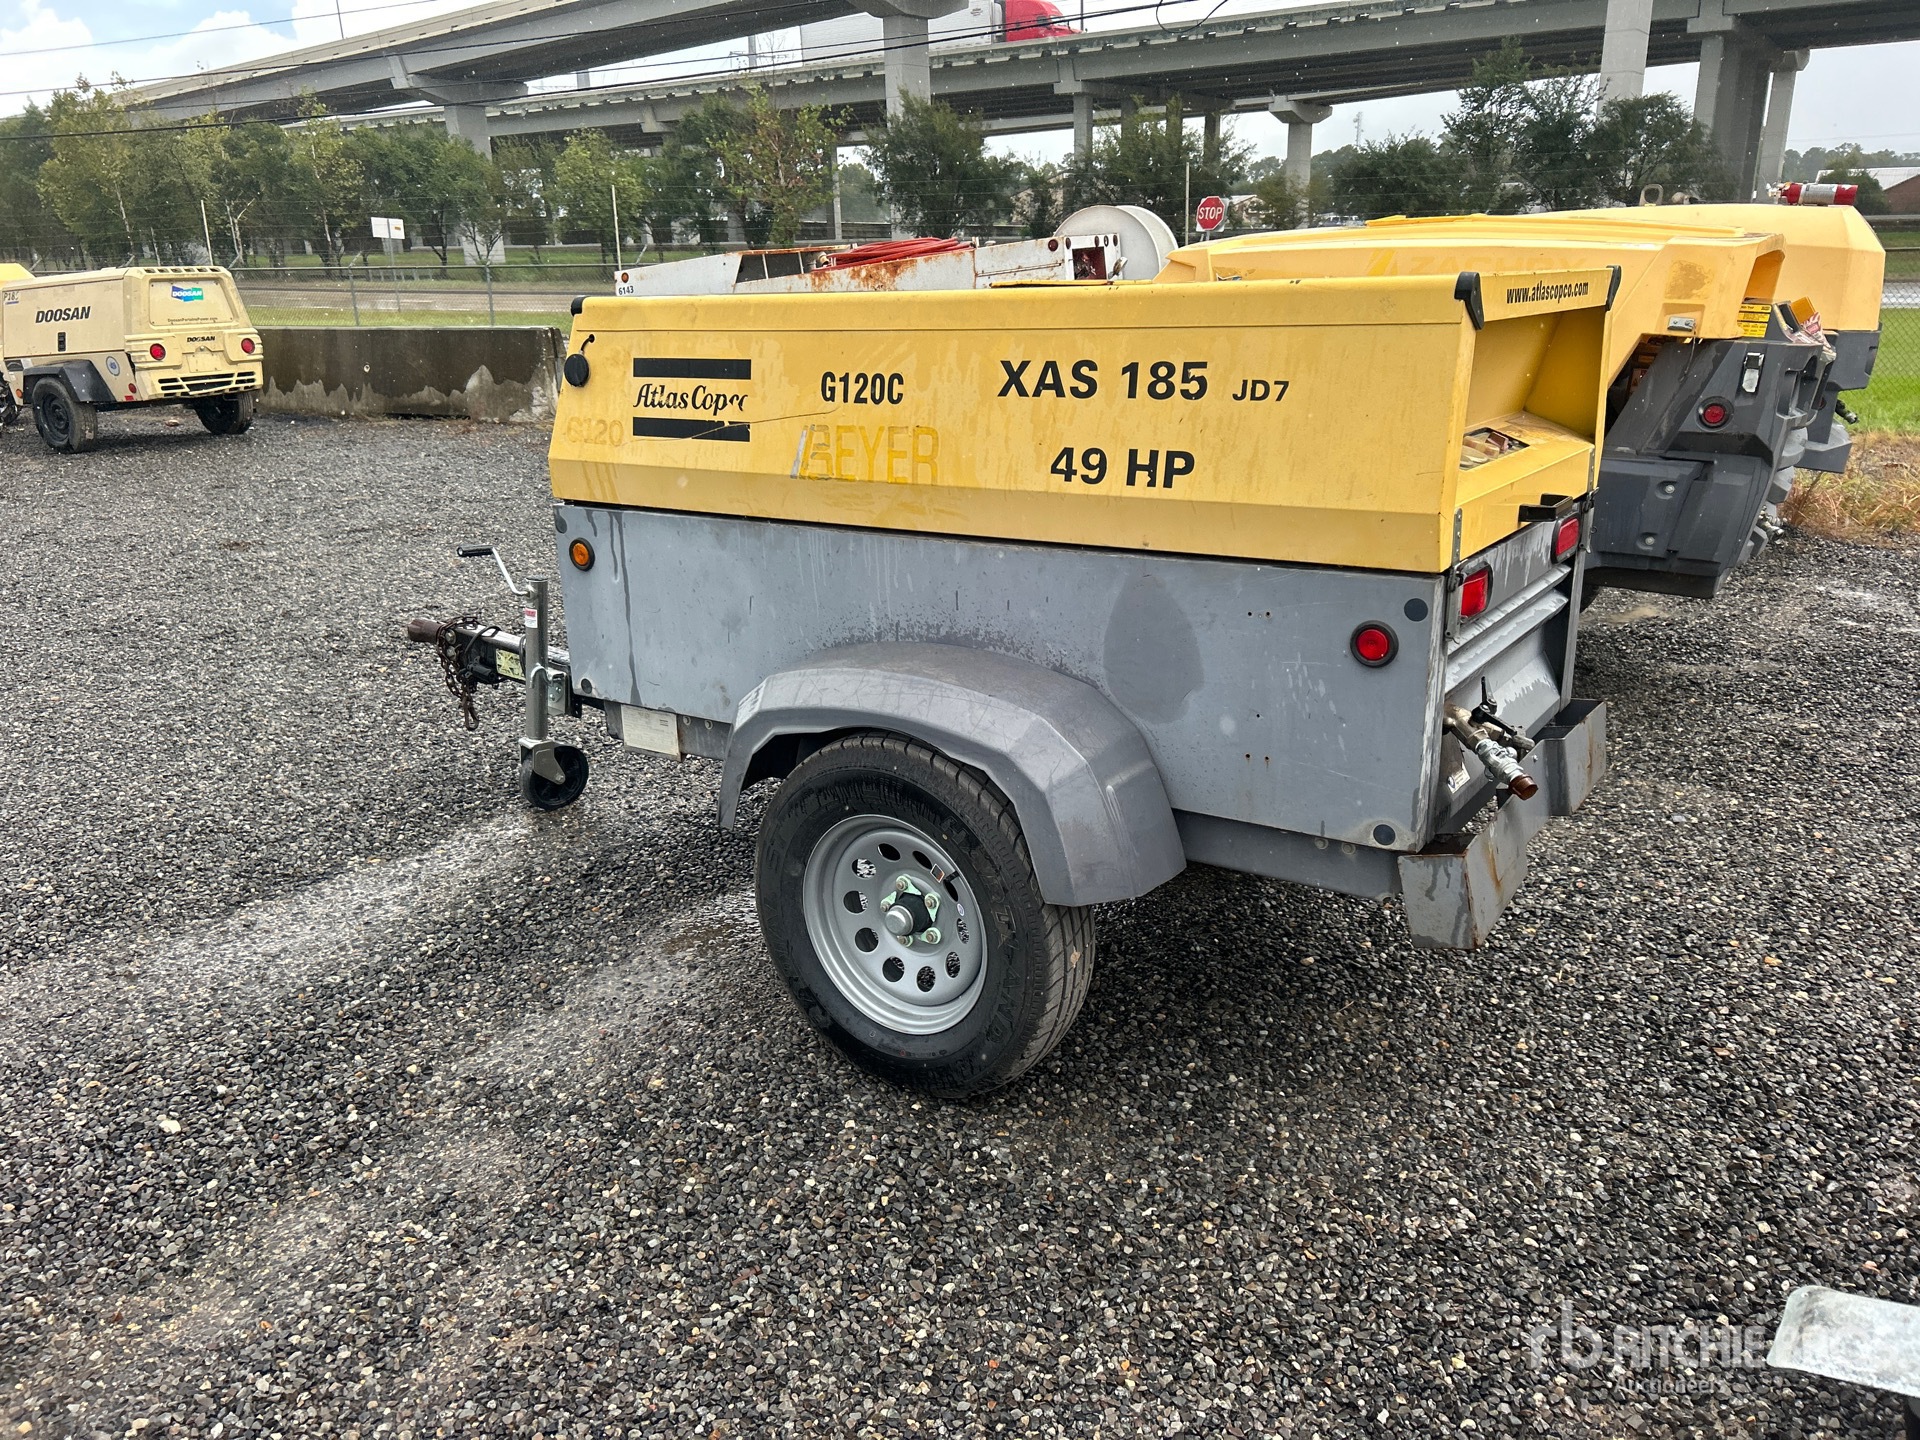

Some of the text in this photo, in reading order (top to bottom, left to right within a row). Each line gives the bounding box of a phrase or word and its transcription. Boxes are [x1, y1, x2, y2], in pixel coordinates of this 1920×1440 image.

[1198, 206, 1223, 220] STOP
[618, 285, 634, 295] 6143
[1506, 280, 1589, 304] www.atlascopco.com
[35, 305, 91, 324] DOOSAN
[187, 335, 216, 343] DOOSAN
[820, 370, 905, 406] G120C
[997, 359, 1290, 403] XAS 185 JD7
[633, 383, 689, 409] Atlas
[1050, 446, 1196, 489] 49 HP
